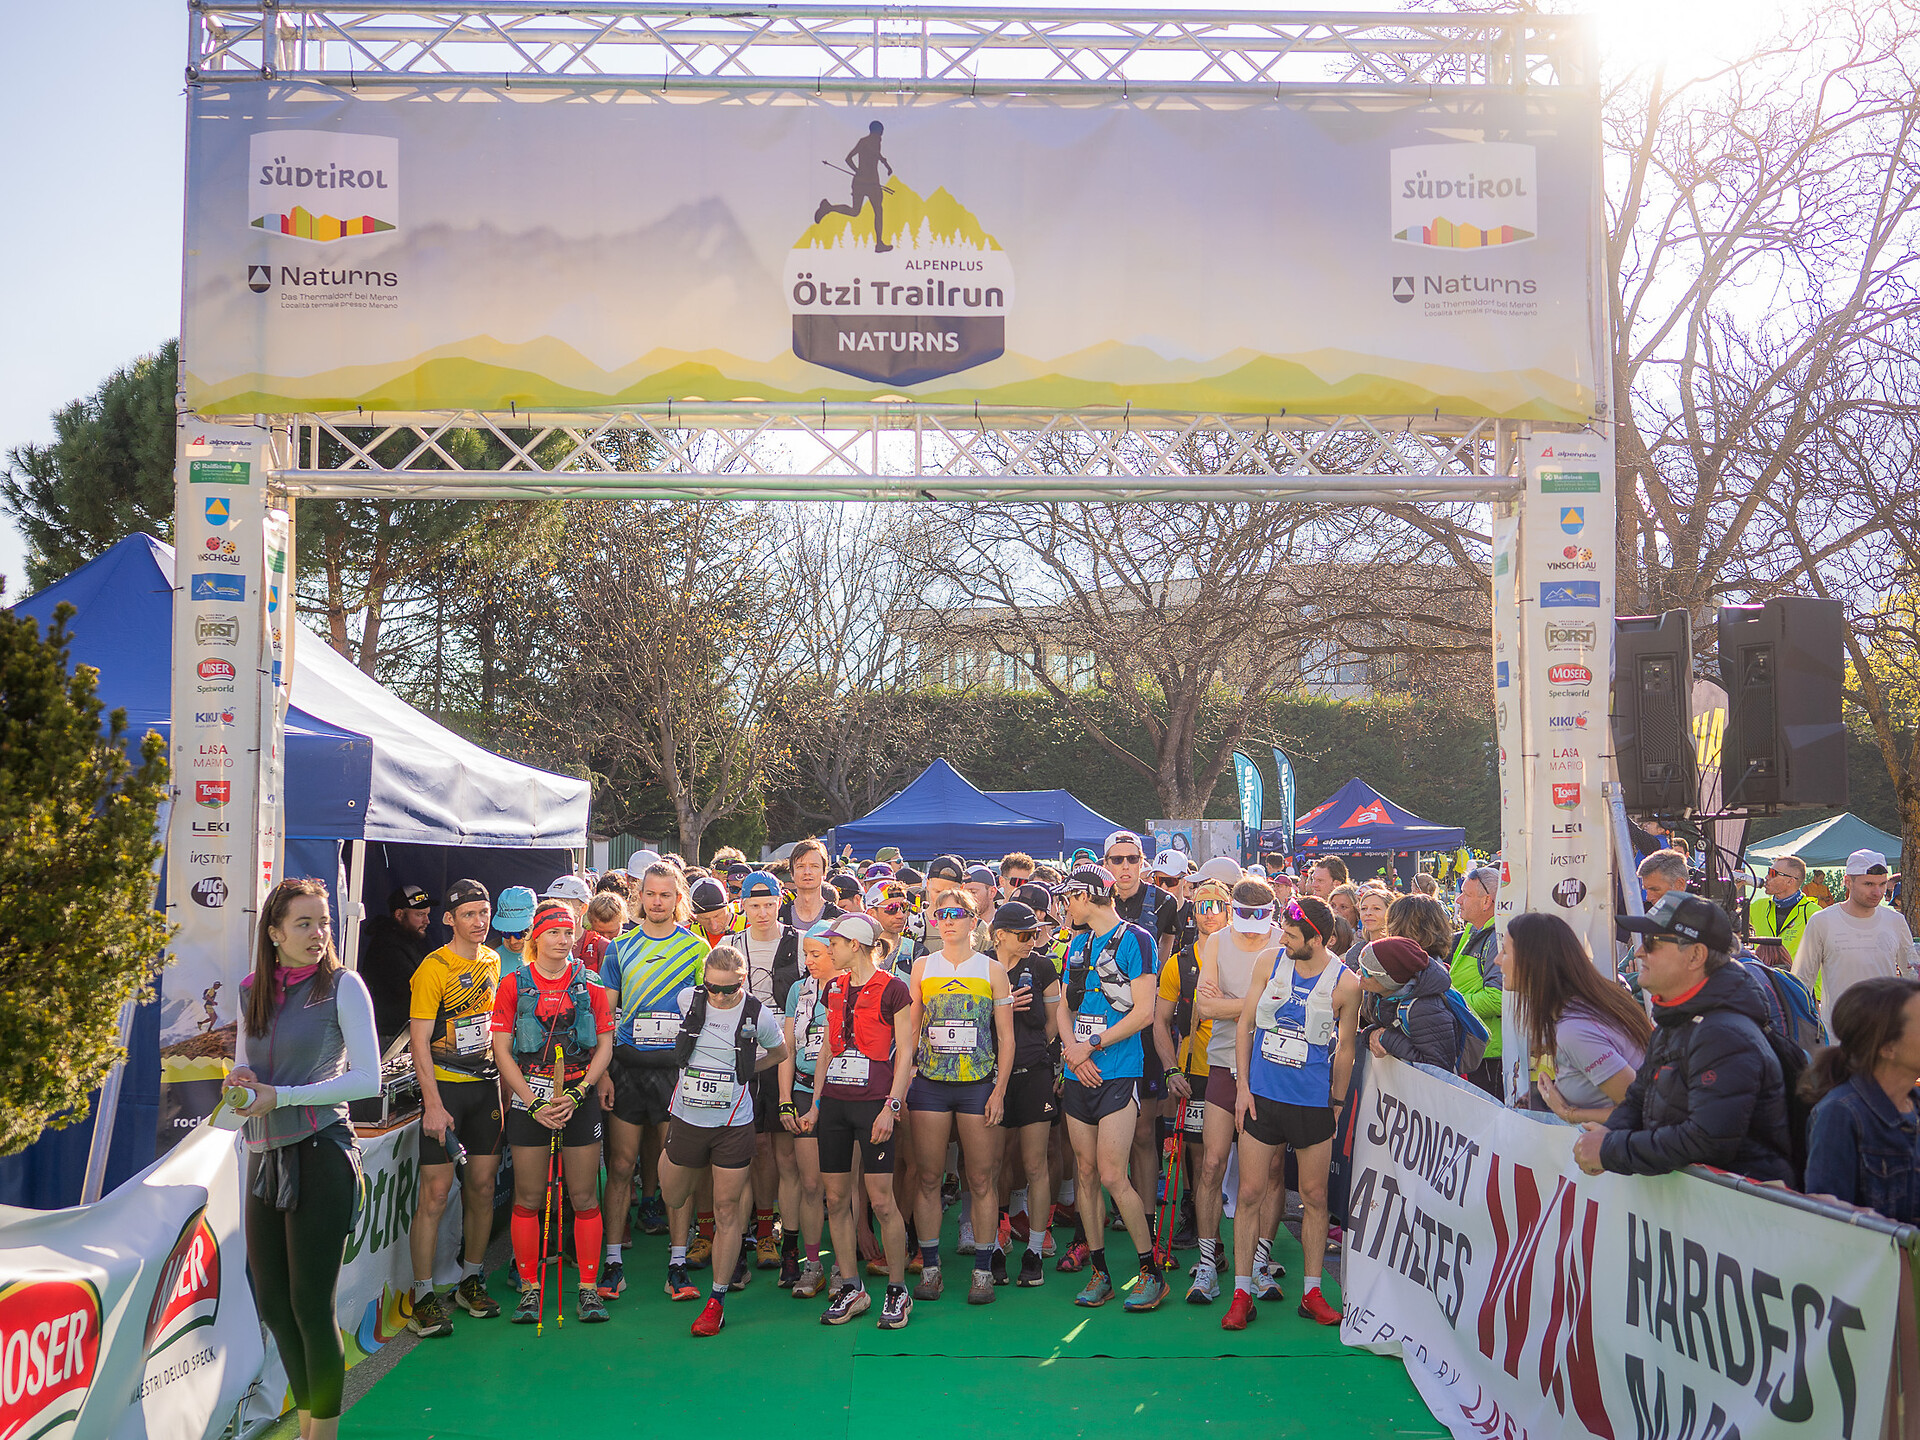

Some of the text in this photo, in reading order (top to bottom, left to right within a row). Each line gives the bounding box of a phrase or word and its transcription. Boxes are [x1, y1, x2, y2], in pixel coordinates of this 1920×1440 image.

[905, 259, 983, 271] ALPENPLUS
[281, 266, 398, 287] Naturns
[792, 272, 1004, 307] Ötzi Trailrun
[1424, 275, 1537, 294] Naturns
[300, 291, 352, 300] Thermaldorf
[355, 292, 368, 300] bei
[369, 293, 398, 301] Meran
[1442, 298, 1495, 308] Thermaldorf
[1509, 301, 1538, 309] Meran
[838, 331, 960, 352] NATURNS
[1557, 450, 1597, 458] alpenplus
[1546, 561, 1597, 571] VINSCHGAU
[1549, 629, 1593, 642] FORST
[1551, 668, 1587, 680] MOSER
[1548, 689, 1590, 699] Speckworld
[1549, 716, 1574, 727] KIKU
[199, 744, 229, 755] LASA
[1553, 748, 1580, 758] LASA
[192, 822, 230, 832] LEKI
[1322, 837, 1371, 847] alpenplus
[1158, 853, 1168, 865] NY
[475, 1025, 481, 1037] 3
[655, 1020, 661, 1031] 1
[948, 1028, 956, 1039] 6
[1279, 1037, 1287, 1048] 7
[841, 1058, 848, 1070] 2
[695, 1080, 717, 1094] 195
[1186, 1107, 1204, 1119] 241
[1625, 1211, 1867, 1440] HARDEST
[0, 1308, 89, 1408] OSER
[164, 1359, 190, 1386] DELLO
[191, 1345, 217, 1371] SPECK
